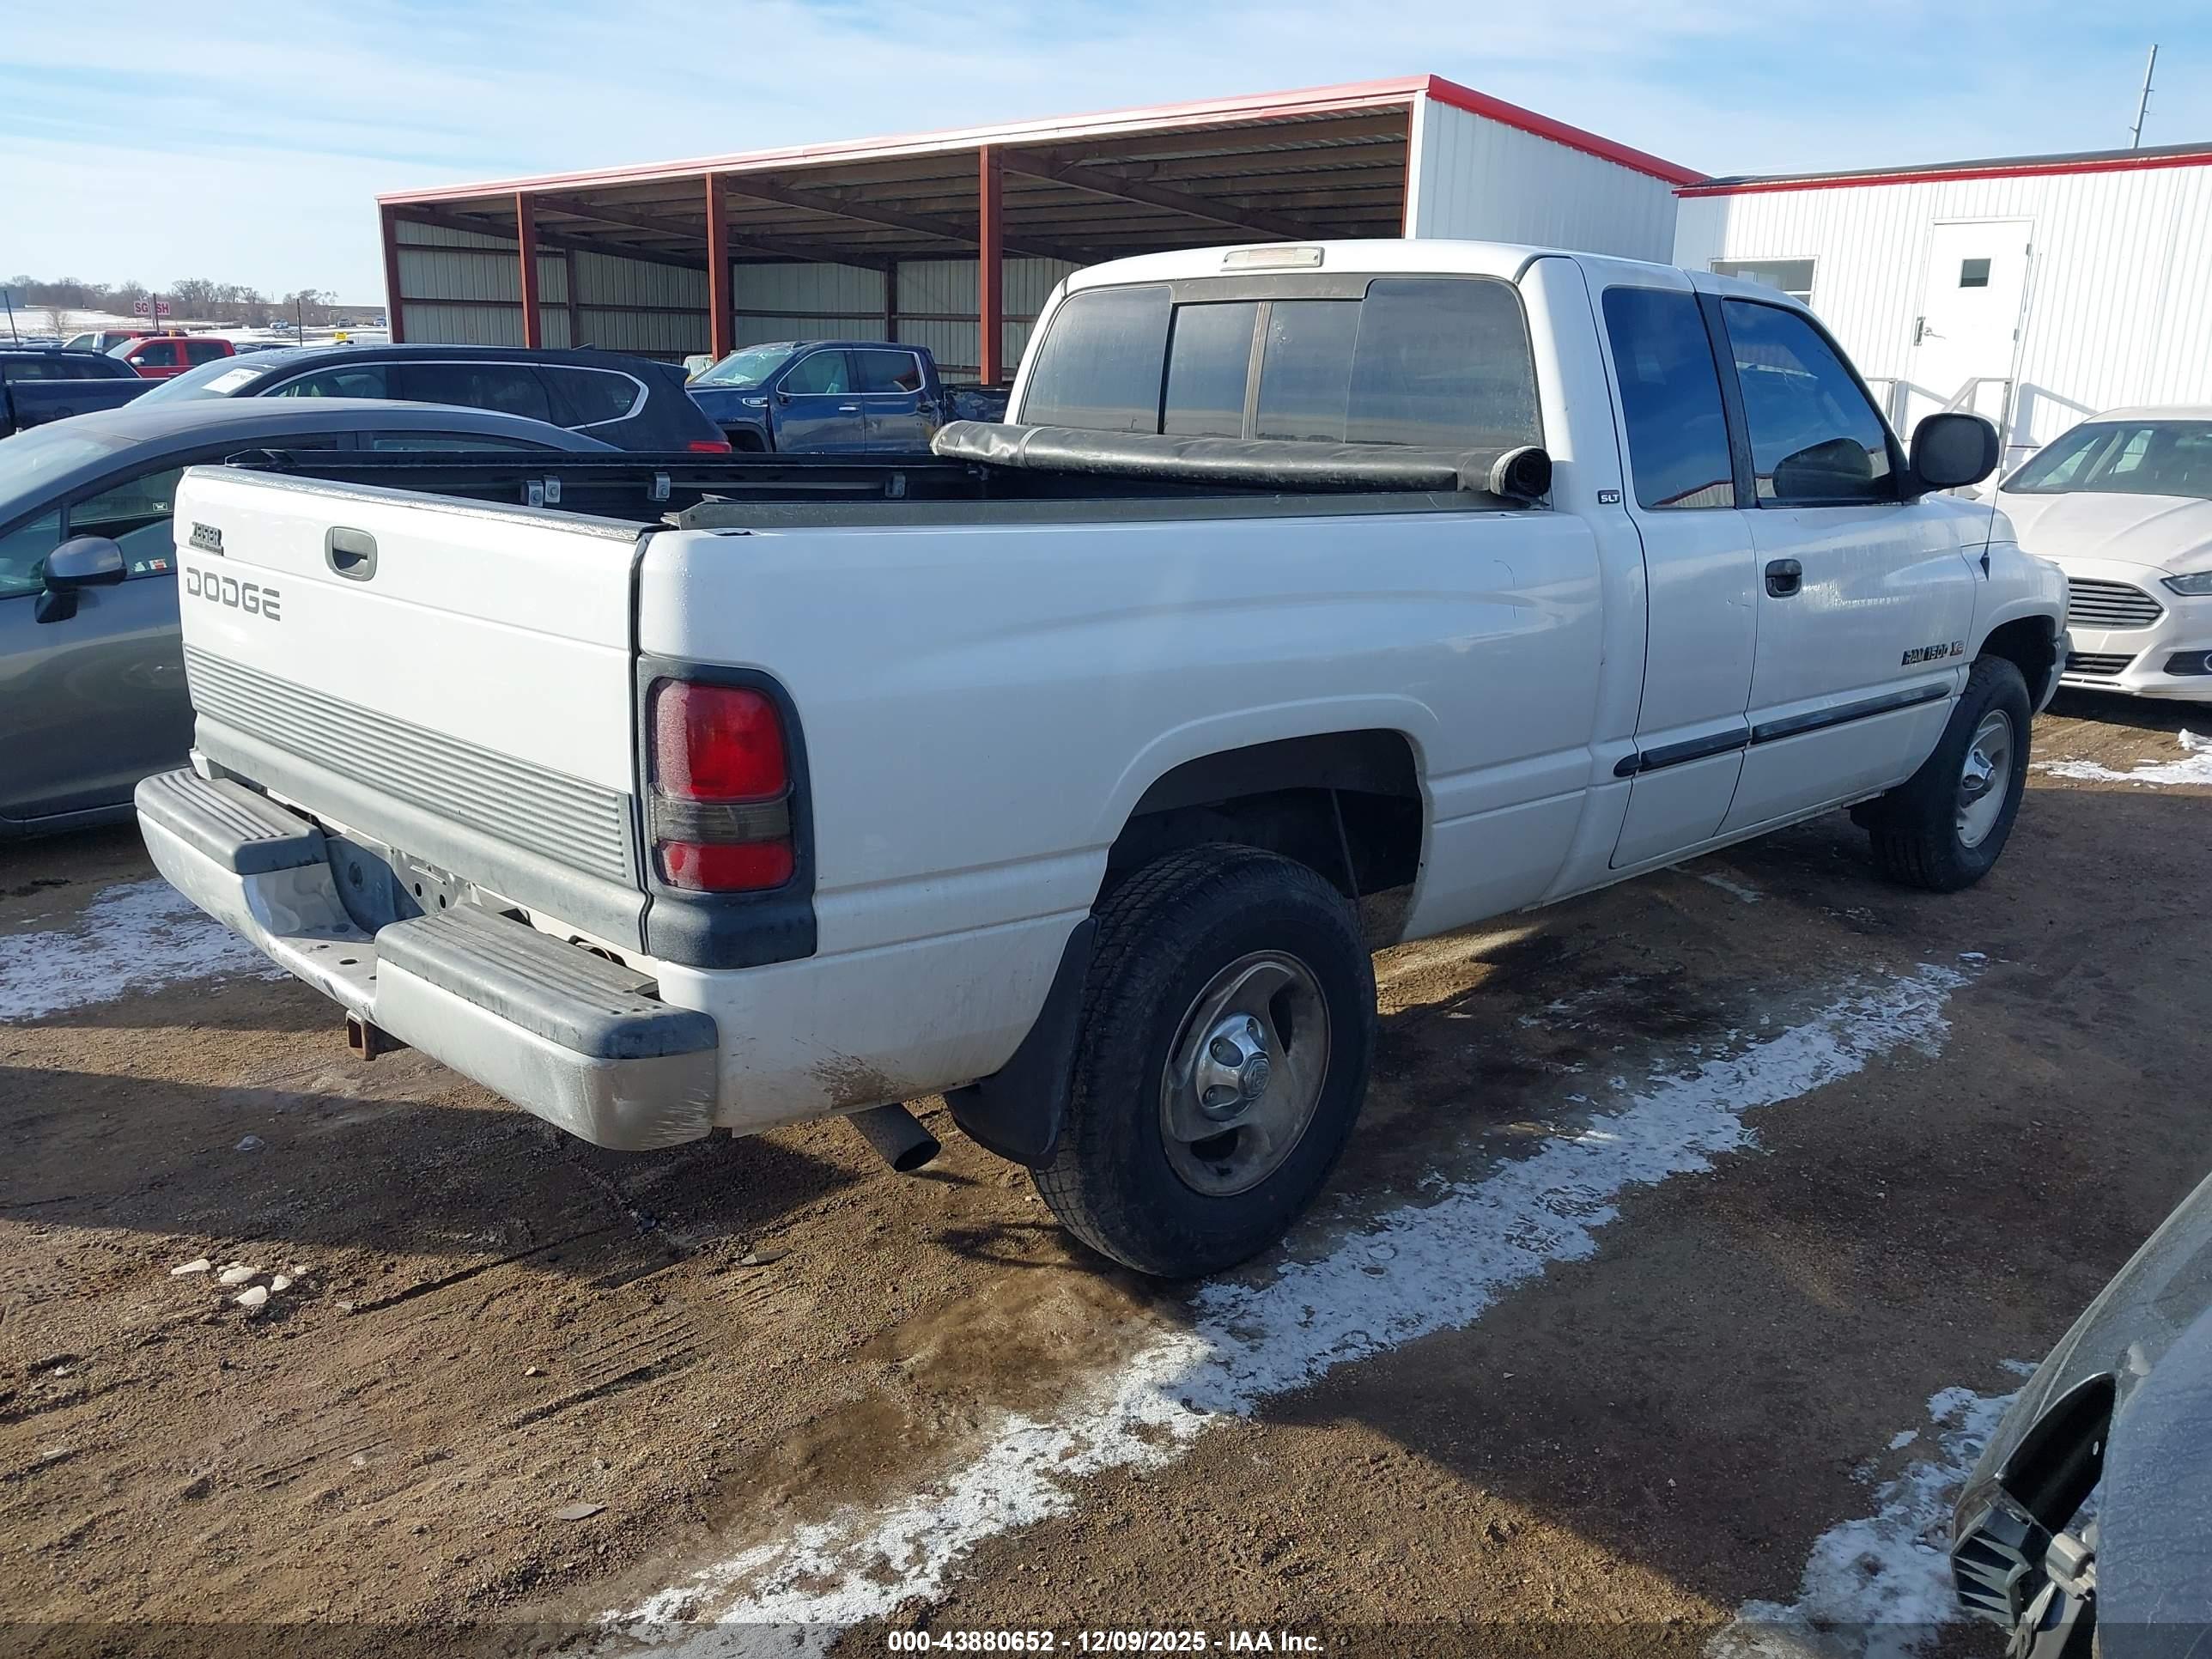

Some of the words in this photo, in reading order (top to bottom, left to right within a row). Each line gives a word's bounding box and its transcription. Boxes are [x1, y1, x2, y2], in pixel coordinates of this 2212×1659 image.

[135, 302, 149, 313] SG
[1601, 494, 1620, 502] SLT
[186, 566, 281, 622] DODGE
[1901, 648, 1925, 665] RAM
